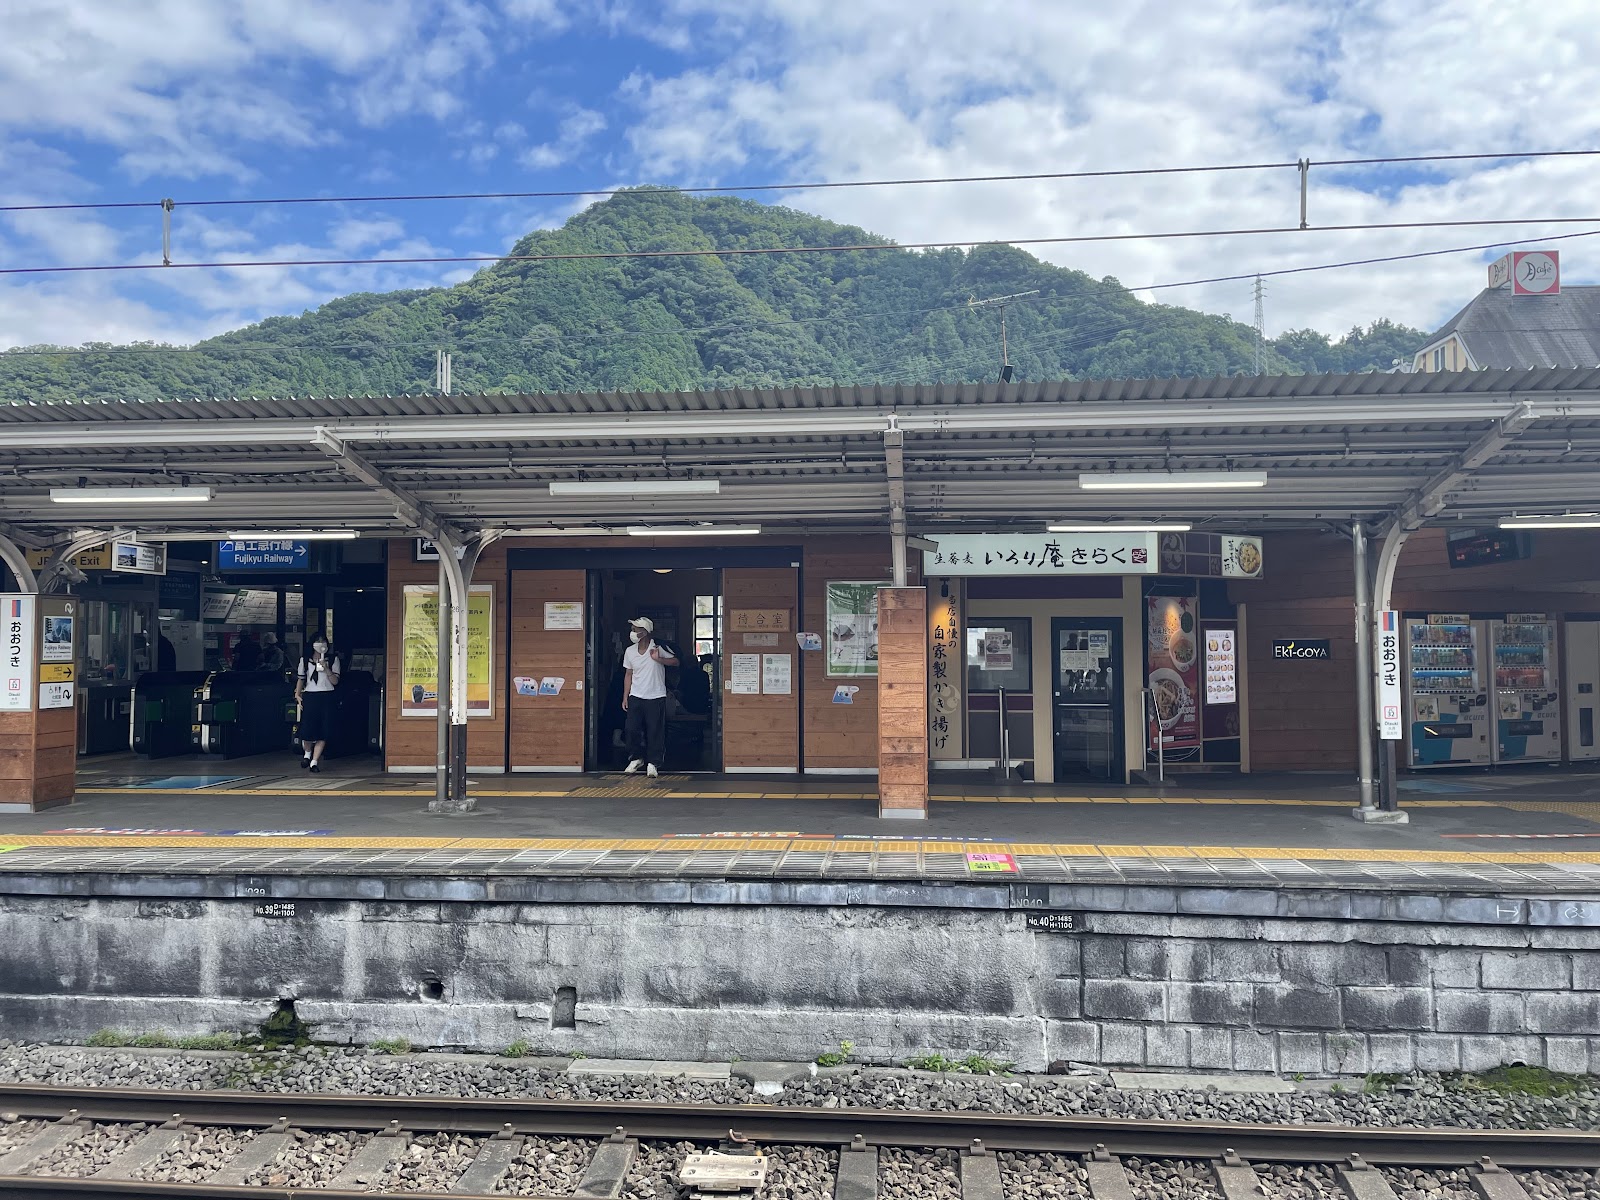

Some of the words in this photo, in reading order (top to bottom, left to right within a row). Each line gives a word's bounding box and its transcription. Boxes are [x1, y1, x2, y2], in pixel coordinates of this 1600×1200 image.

[80, 556, 100, 566] Exit
[234, 553, 262, 564] Fujikyu
[263, 553, 294, 564] Railway
[934, 551, 975, 565] 生蕎麦
[738, 612, 783, 625] 待合室
[946, 594, 959, 649] 当店自慢の
[10, 621, 22, 668] おおつき
[1383, 635, 1396, 686] おおつき
[932, 624, 950, 750] 自家製かき揚げ
[1028, 916, 1049, 926] No.40
[1049, 914, 1073, 922] D=1485
